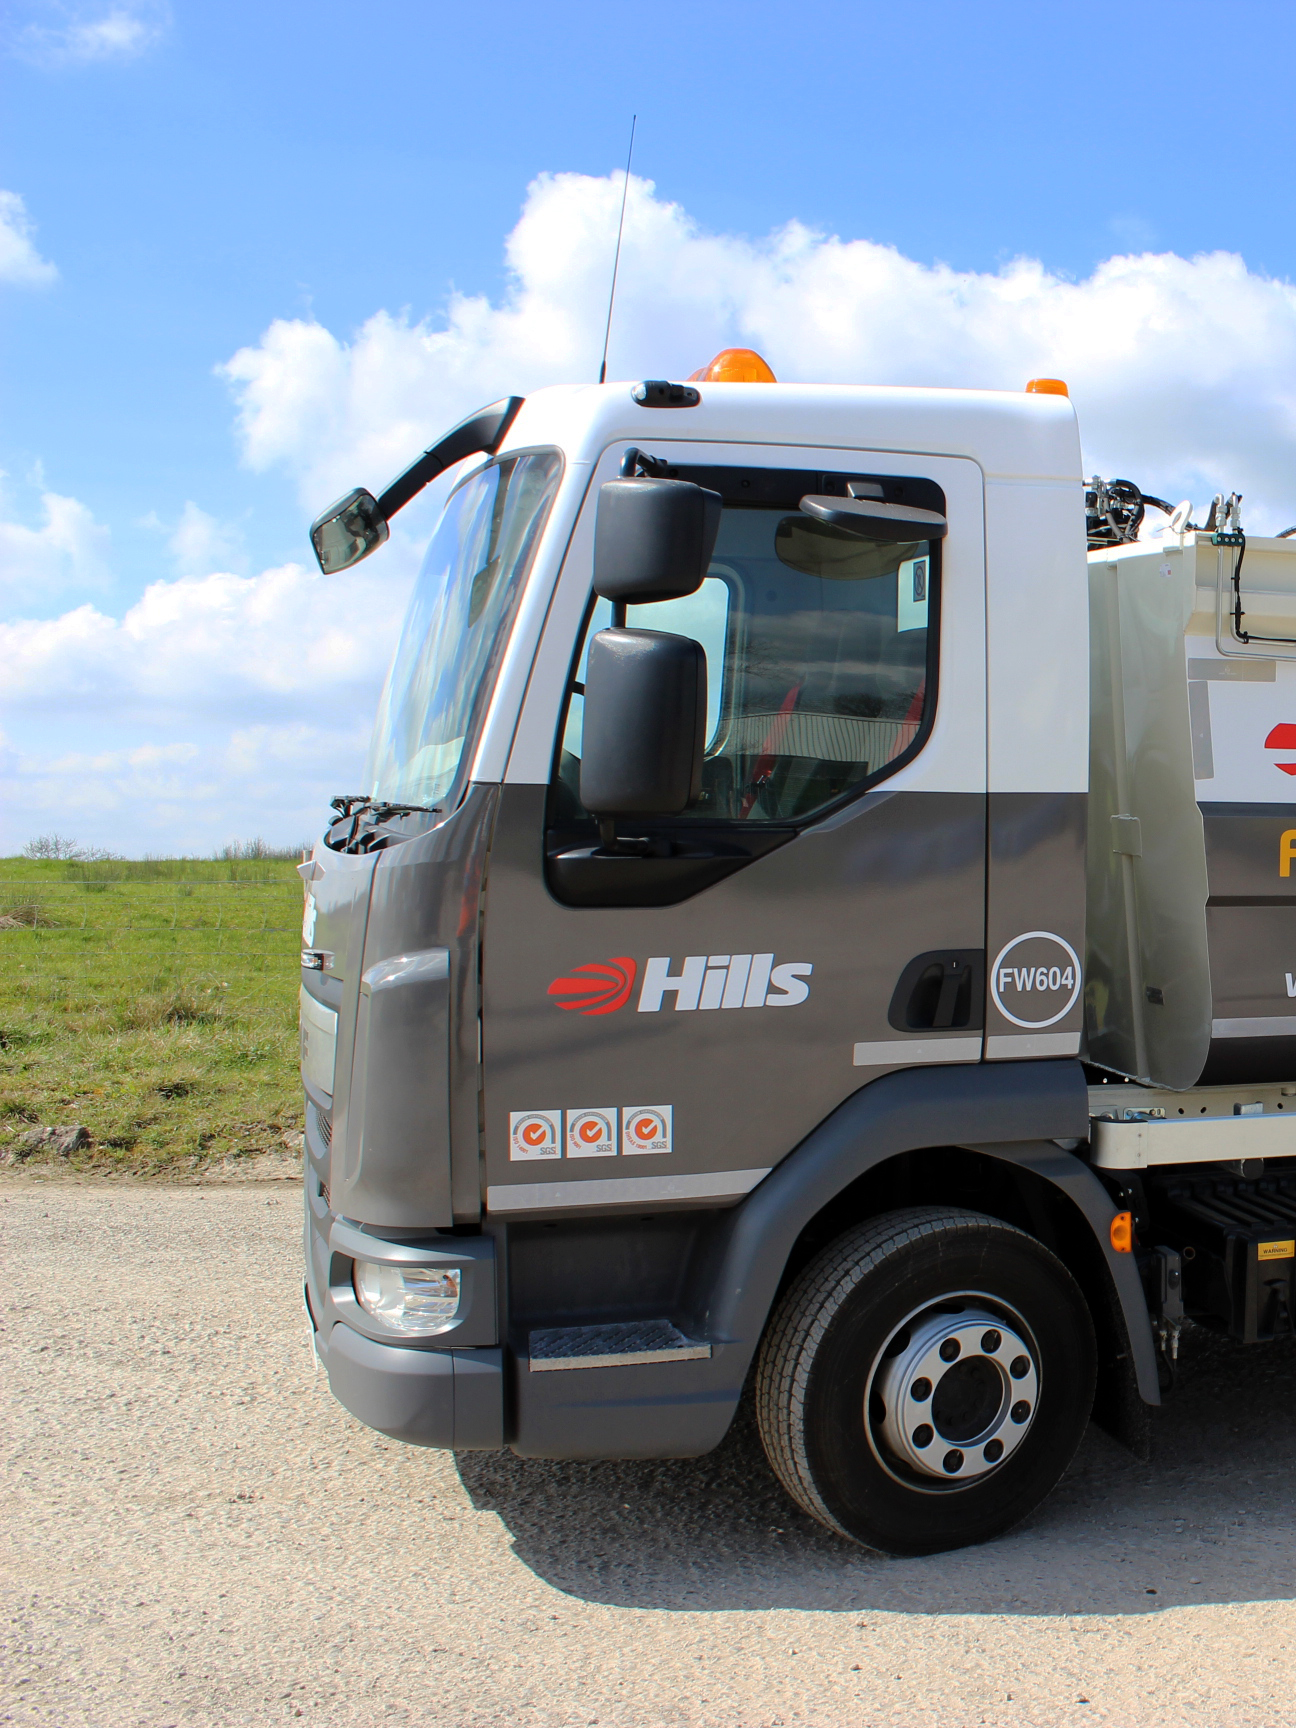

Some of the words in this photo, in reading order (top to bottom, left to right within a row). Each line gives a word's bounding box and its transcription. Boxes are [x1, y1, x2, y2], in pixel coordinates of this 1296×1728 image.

[637, 953, 813, 1013] Hills
[999, 966, 1074, 993] FW604
[596, 1144, 612, 1153] SGS
[651, 1141, 667, 1150] SGS
[540, 1147, 557, 1155] SGS
